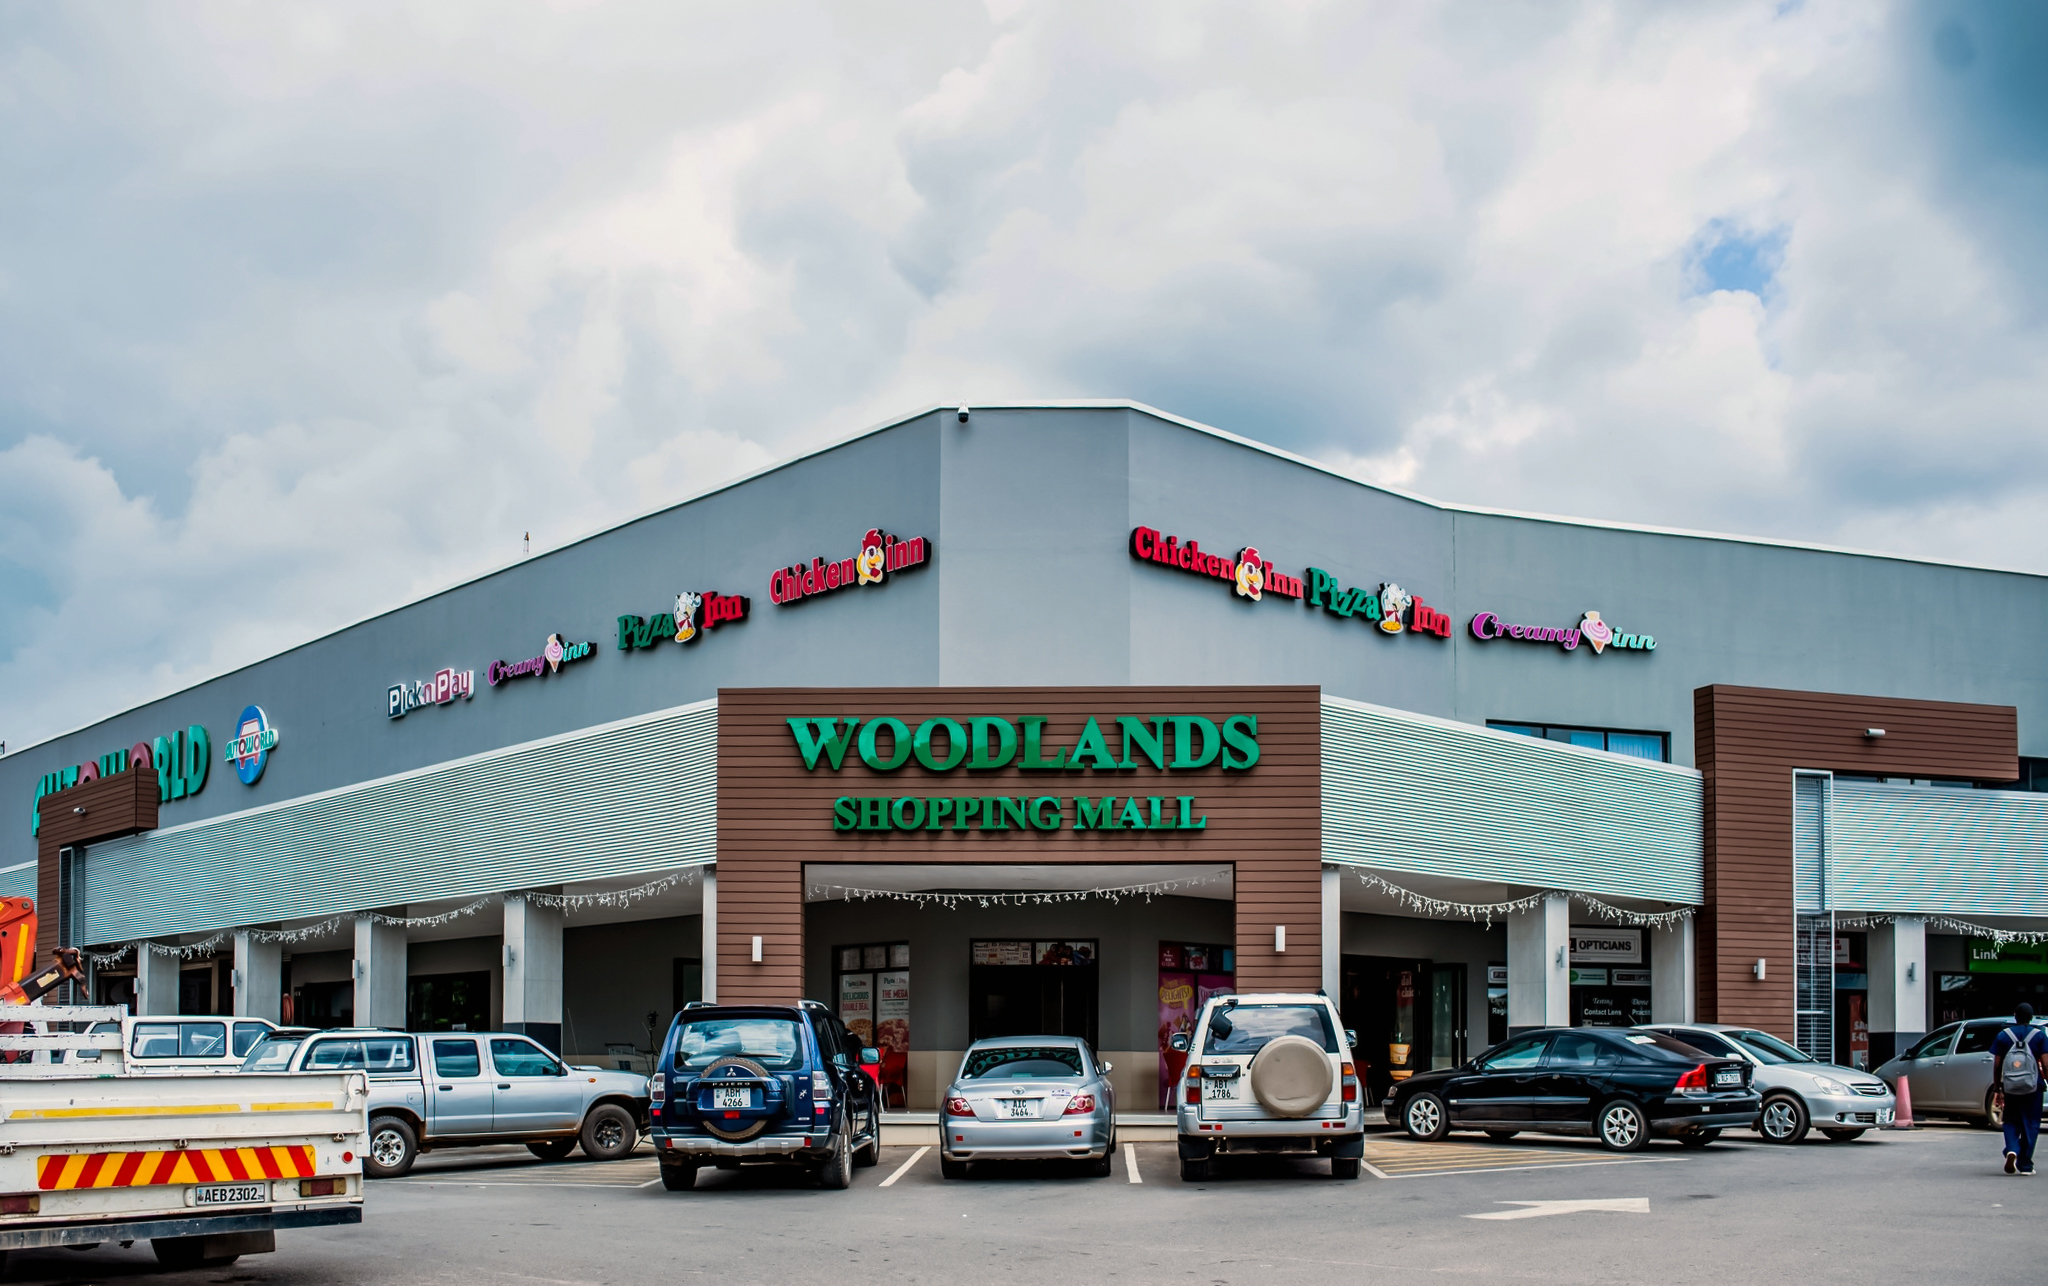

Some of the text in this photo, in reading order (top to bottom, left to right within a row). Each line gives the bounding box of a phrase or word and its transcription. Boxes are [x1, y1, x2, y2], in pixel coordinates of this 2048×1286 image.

[1134, 525, 1304, 599] Chicken Inn
[769, 534, 924, 605] Chicken inn
[1308, 566, 1452, 638] Pizza Inn
[617, 591, 743, 650] Pizza Inn
[1472, 611, 1657, 650] Creamy inn
[487, 641, 591, 687] Creamy inn
[225, 730, 274, 760] AUTOWORLD
[786, 714, 1260, 772] WOODLANDS
[833, 796, 1208, 831] SHOPPING MALL
[1578, 940, 1632, 951] OPTICIANS
[1973, 948, 1998, 960] Link
[842, 991, 870, 1001] DELICIOUS
[882, 988, 909, 999] THE MEGA
[842, 1002, 870, 1012] DOUBLE DEAL
[1583, 1008, 1622, 1016] Contact Lens
[1214, 1079, 1229, 1089] ABT
[725, 1088, 741, 1098] ABM
[1212, 1089, 1231, 1099] 1786
[722, 1098, 743, 1107] 4266
[1012, 1100, 1027, 1109] AIC
[1010, 1108, 1029, 1117] 3464
[204, 1187, 258, 1203] AEB2302
